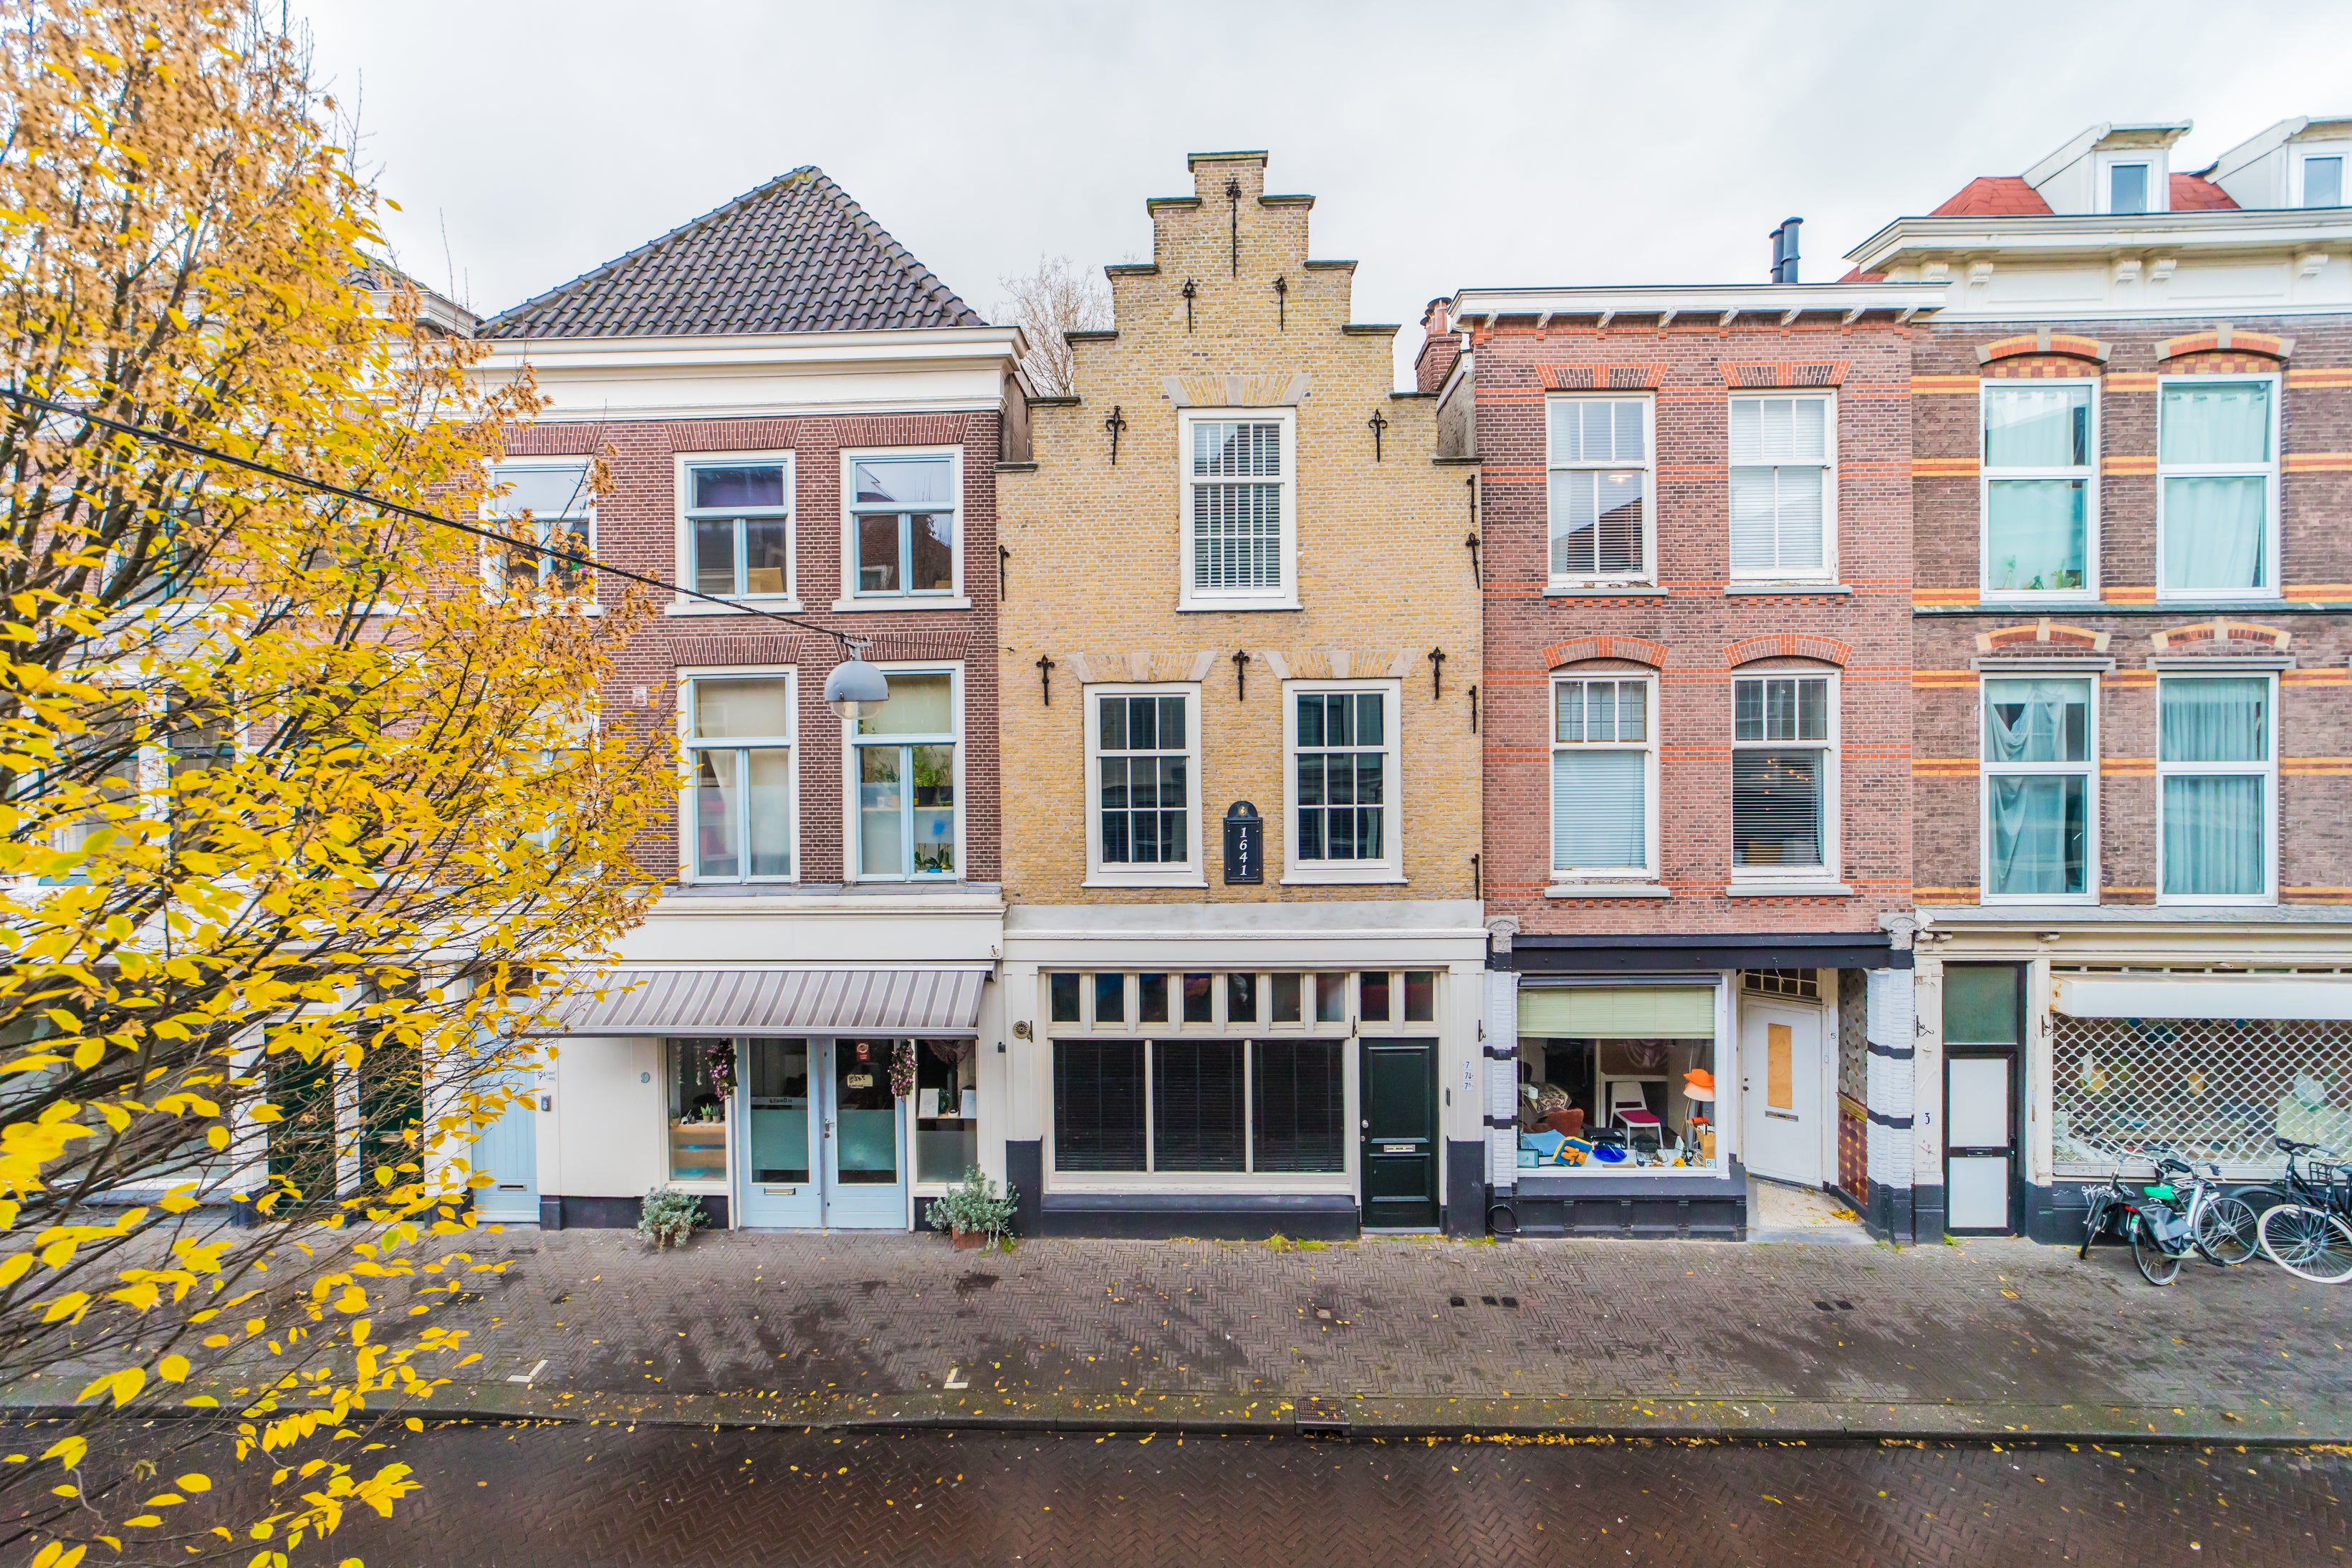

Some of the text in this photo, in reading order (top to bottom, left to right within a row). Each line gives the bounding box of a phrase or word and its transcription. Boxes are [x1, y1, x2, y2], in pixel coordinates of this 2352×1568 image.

[1239, 827, 1248, 876] 1641
[640, 1072, 651, 1084] 9
[1924, 1112, 1930, 1125] 3
